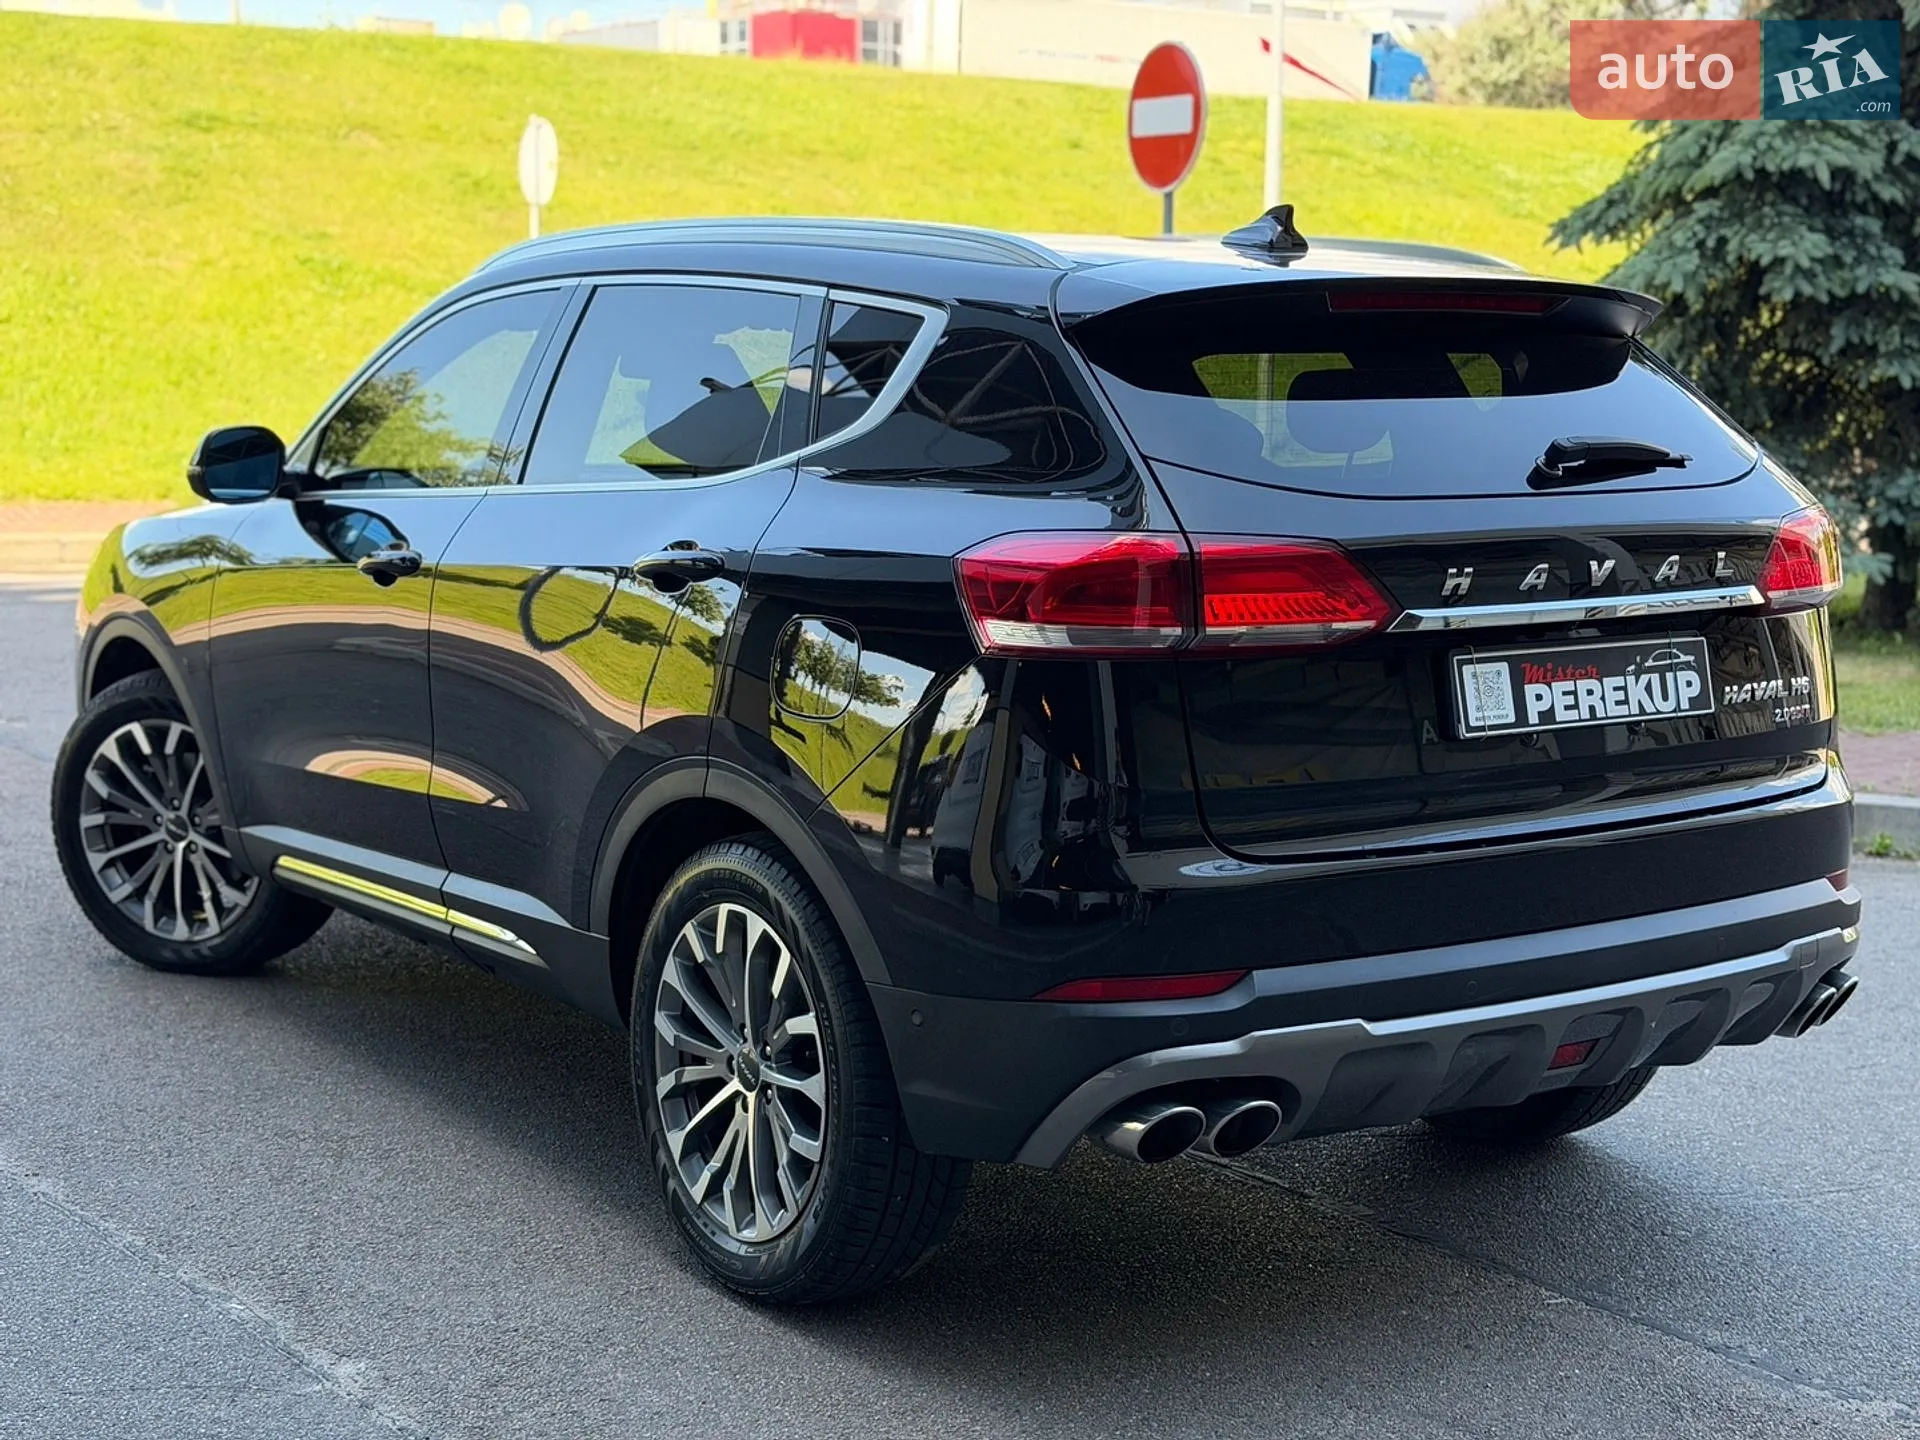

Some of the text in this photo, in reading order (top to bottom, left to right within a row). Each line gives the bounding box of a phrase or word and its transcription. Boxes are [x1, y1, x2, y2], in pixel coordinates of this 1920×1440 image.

[1441, 551, 1735, 596] HAVAL
[1519, 661, 1601, 683] Mister
[1722, 676, 1810, 705] HAVAL H6
[1523, 670, 1701, 726] PEREKUP
